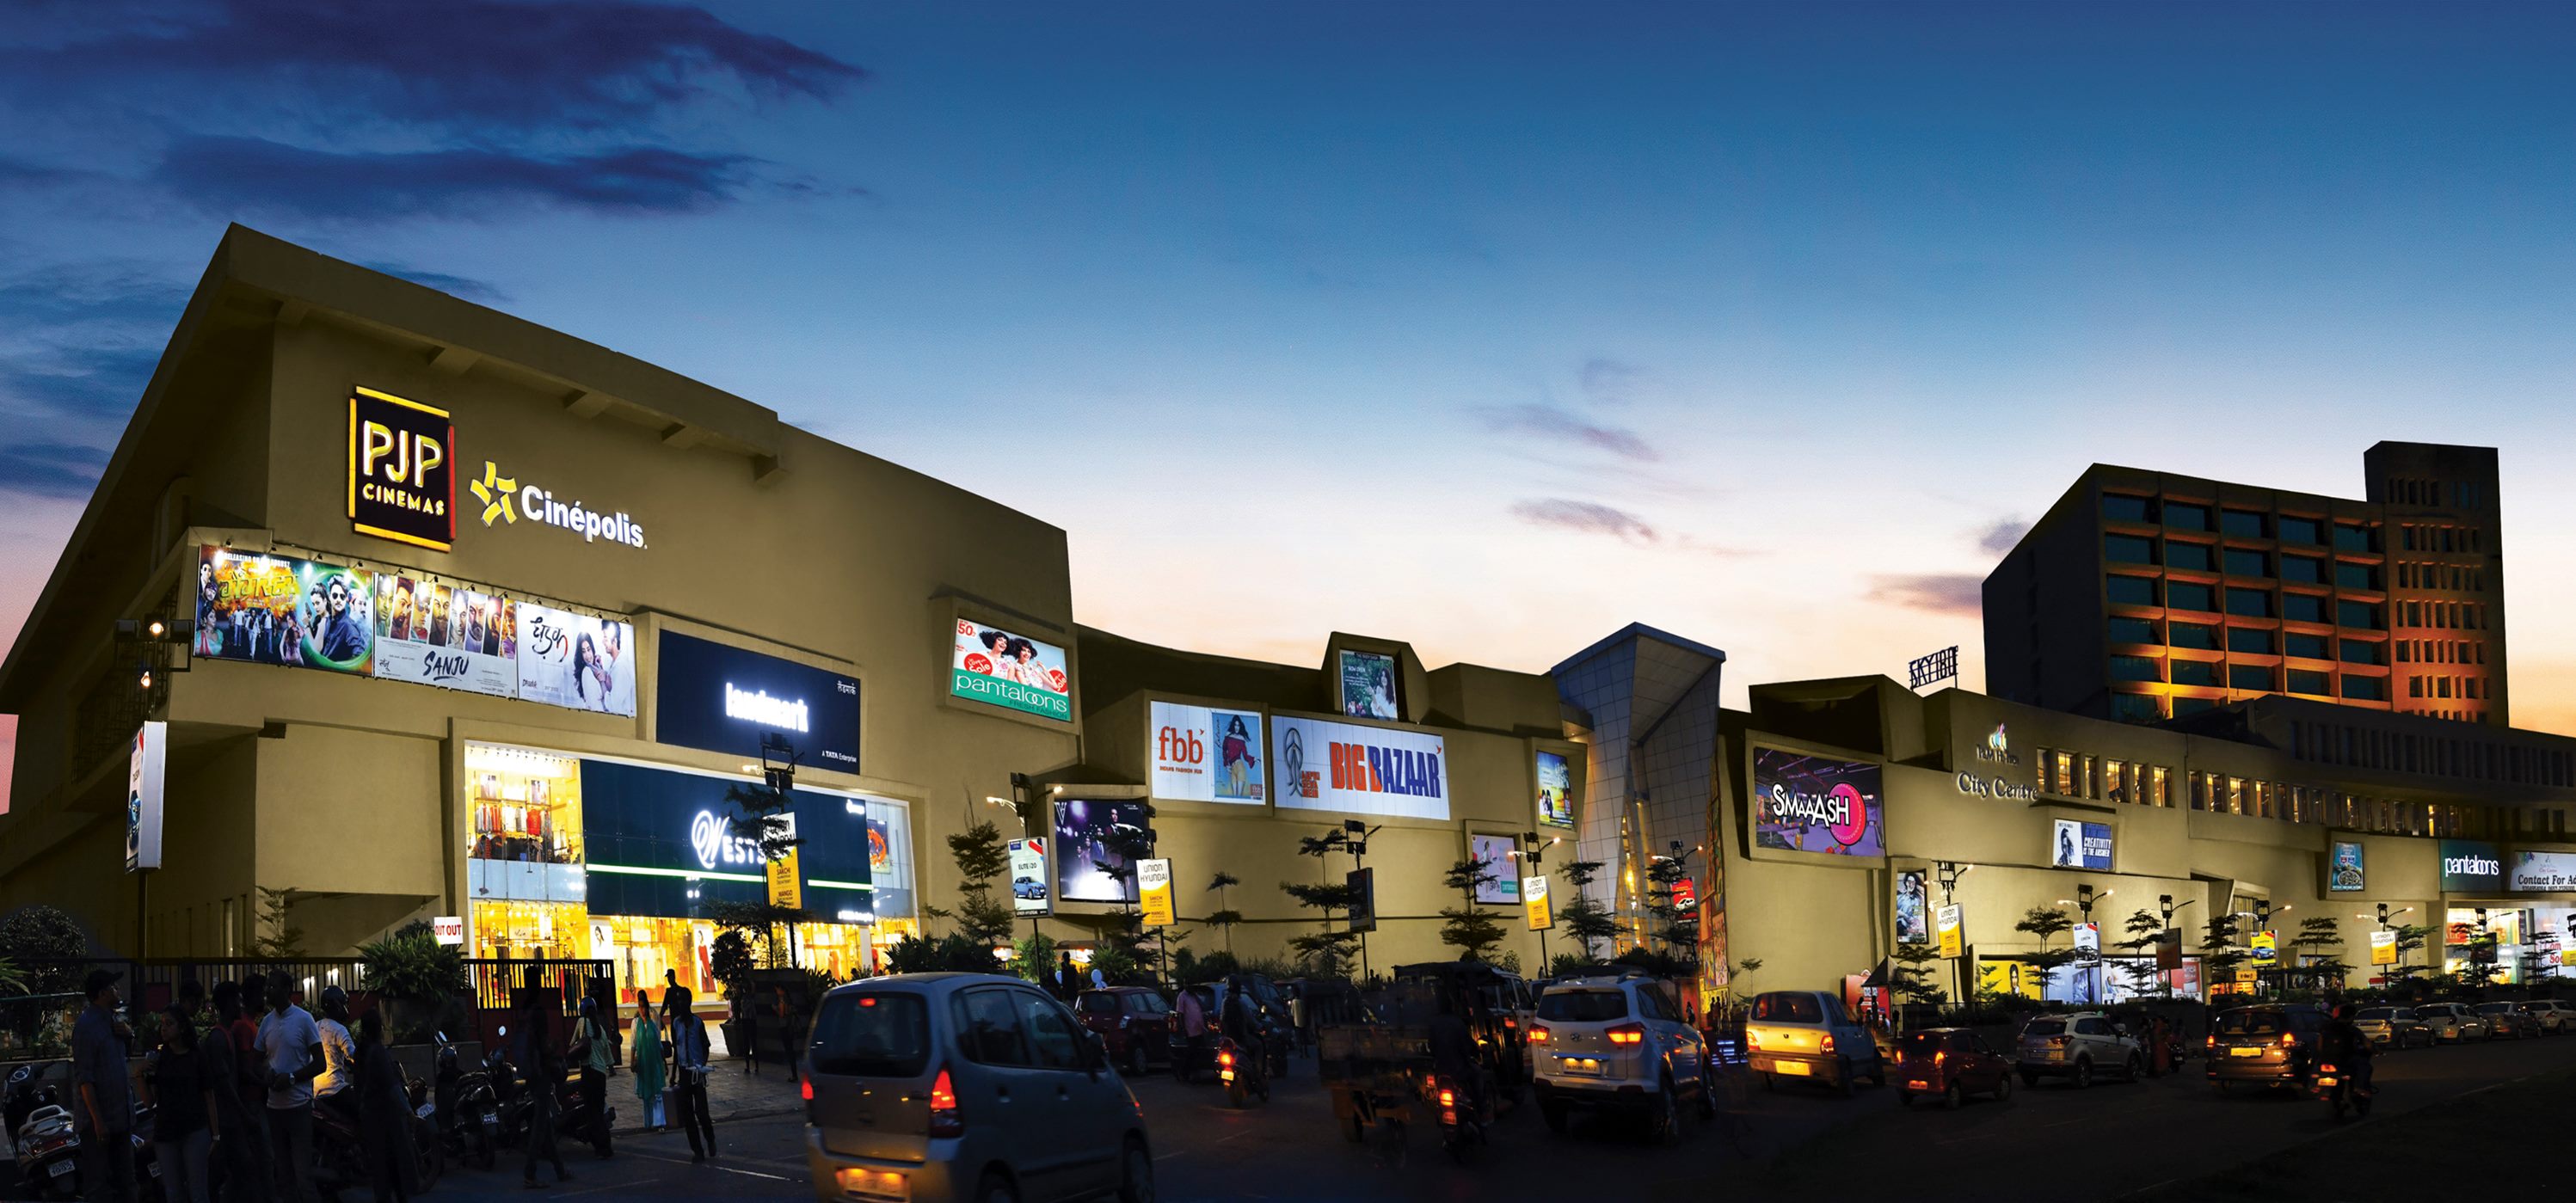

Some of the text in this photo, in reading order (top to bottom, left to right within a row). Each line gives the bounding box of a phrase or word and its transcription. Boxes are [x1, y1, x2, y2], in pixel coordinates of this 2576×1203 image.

[363, 420, 444, 488] PJP
[362, 482, 445, 516] CINEMAS
[422, 651, 470, 678] SANJU
[726, 682, 808, 733] landmark
[956, 675, 1067, 713] pantaloons
[826, 751, 839, 759] TATA
[1159, 726, 1204, 764] fbb
[1329, 741, 1442, 798] BIG BAZAAR
[1958, 770, 2038, 801] City Centre
[1773, 783, 1850, 827] SMAAASH
[2084, 837, 2112, 850] CREATIVITY
[1140, 874, 1167, 882] HYUNDAI
[1144, 864, 1163, 873] UNION
[2444, 855, 2499, 877] pantaloons
[2518, 874, 2549, 885] Contact
[2552, 875, 2566, 885] For
[446, 924, 462, 936] OUT
